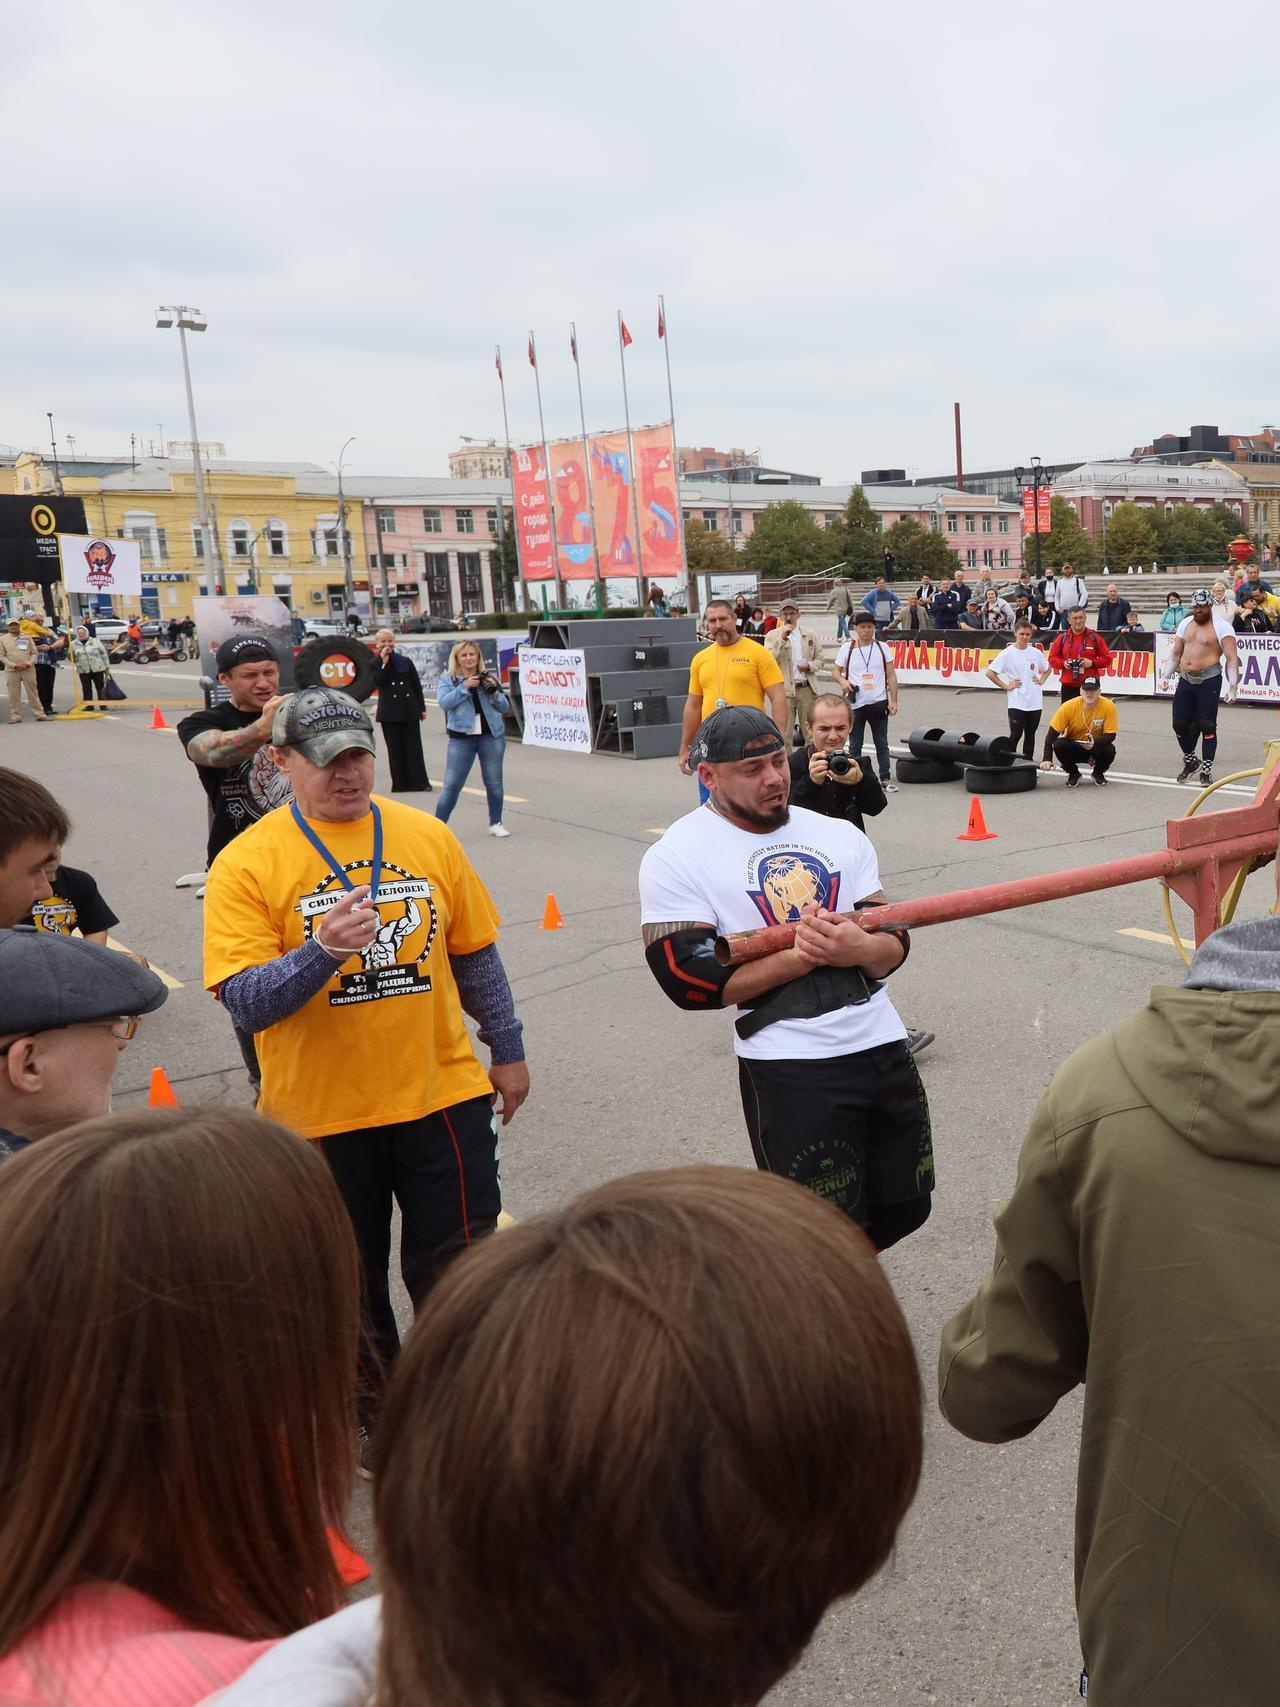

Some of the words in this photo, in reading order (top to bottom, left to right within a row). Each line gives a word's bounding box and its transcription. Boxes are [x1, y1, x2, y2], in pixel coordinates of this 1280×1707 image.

[143, 574, 178, 582] ТЕКА
[1237, 639, 1280, 651] ФИТНЕС
[635, 651, 646, 660] 200
[299, 704, 361, 726] NB76NYC
[766, 843, 790, 851] NATION
[801, 845, 814, 853] THE
[815, 850, 834, 868] WORLD
[331, 992, 381, 1005] СИЛОВОГО
[382, 983, 431, 996] ЭКСТРИМА
[346, 977, 414, 994] ФЕРАЦИЯ
[813, 1166, 857, 1196] ENUM
